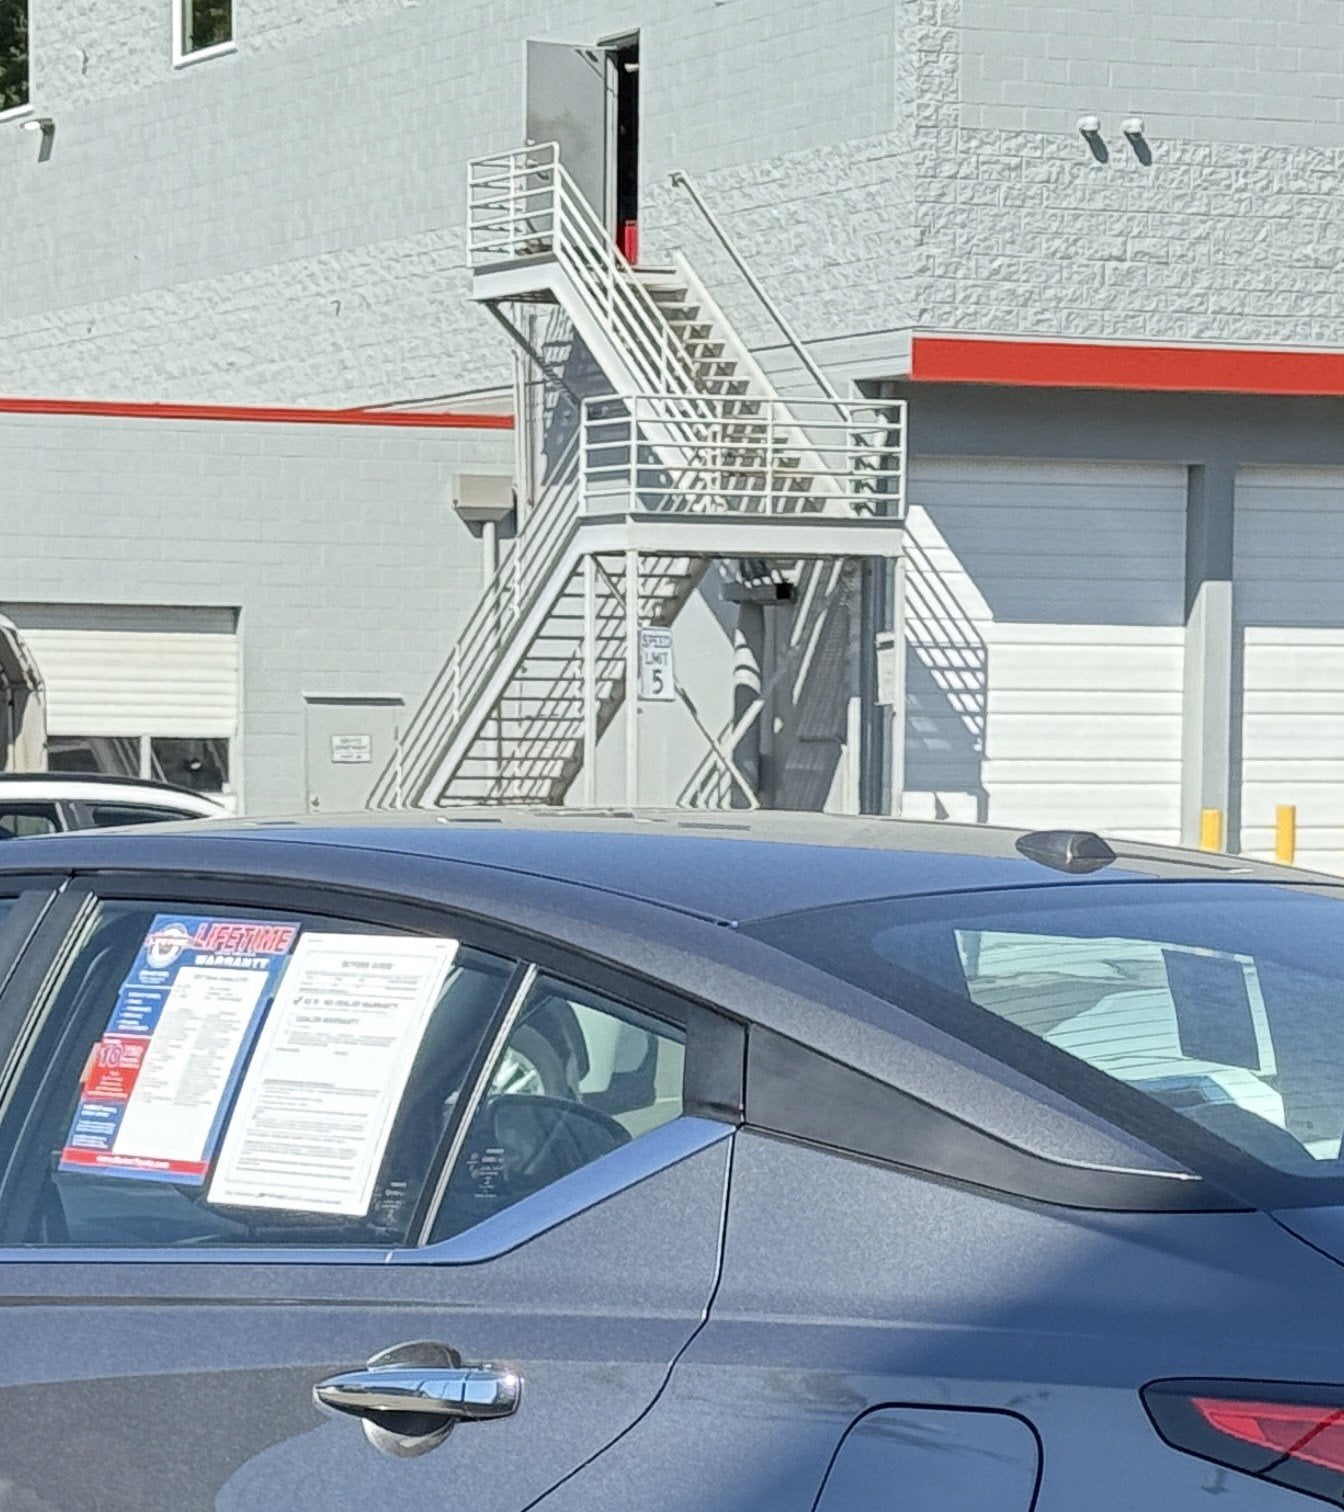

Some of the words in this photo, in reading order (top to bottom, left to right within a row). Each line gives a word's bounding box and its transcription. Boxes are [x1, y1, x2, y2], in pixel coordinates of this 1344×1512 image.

[652, 668, 664, 694] 5
[192, 922, 296, 955] LIFETIME
[194, 954, 270, 969] WARRANTY
